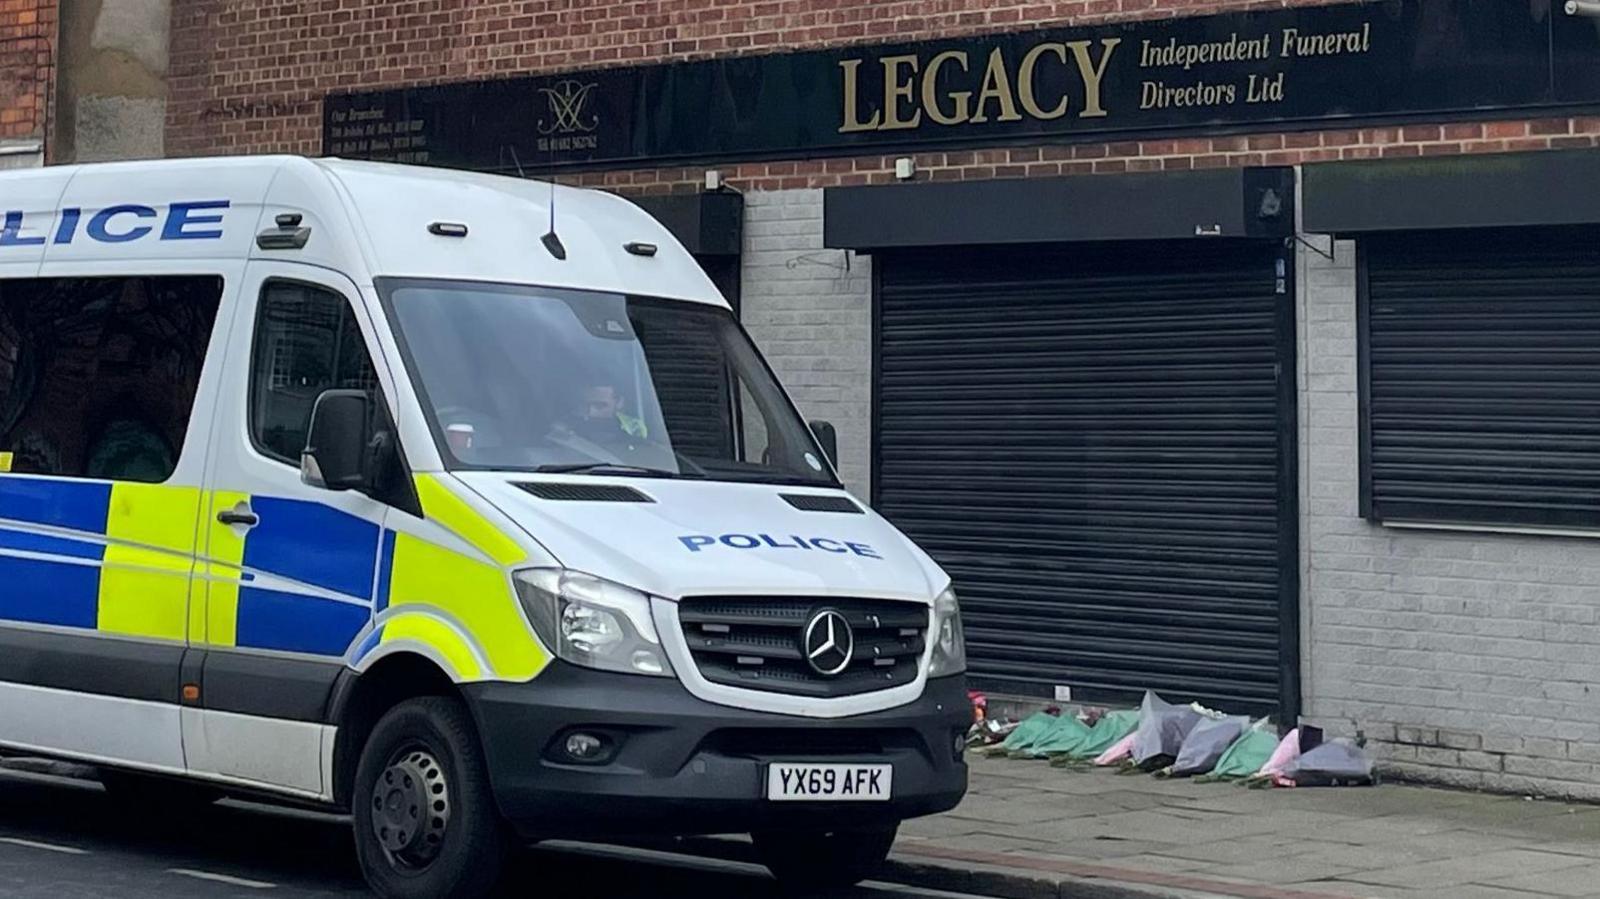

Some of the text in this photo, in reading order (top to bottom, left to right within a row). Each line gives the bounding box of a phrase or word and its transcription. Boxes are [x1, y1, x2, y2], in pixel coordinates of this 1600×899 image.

[1140, 22, 1370, 70] Independent Funeral
[838, 38, 1121, 133] LEGACY
[1139, 72, 1284, 110] Directors Ltd
[678, 534, 883, 560] POLICE
[780, 768, 882, 794] YX69 AFK
